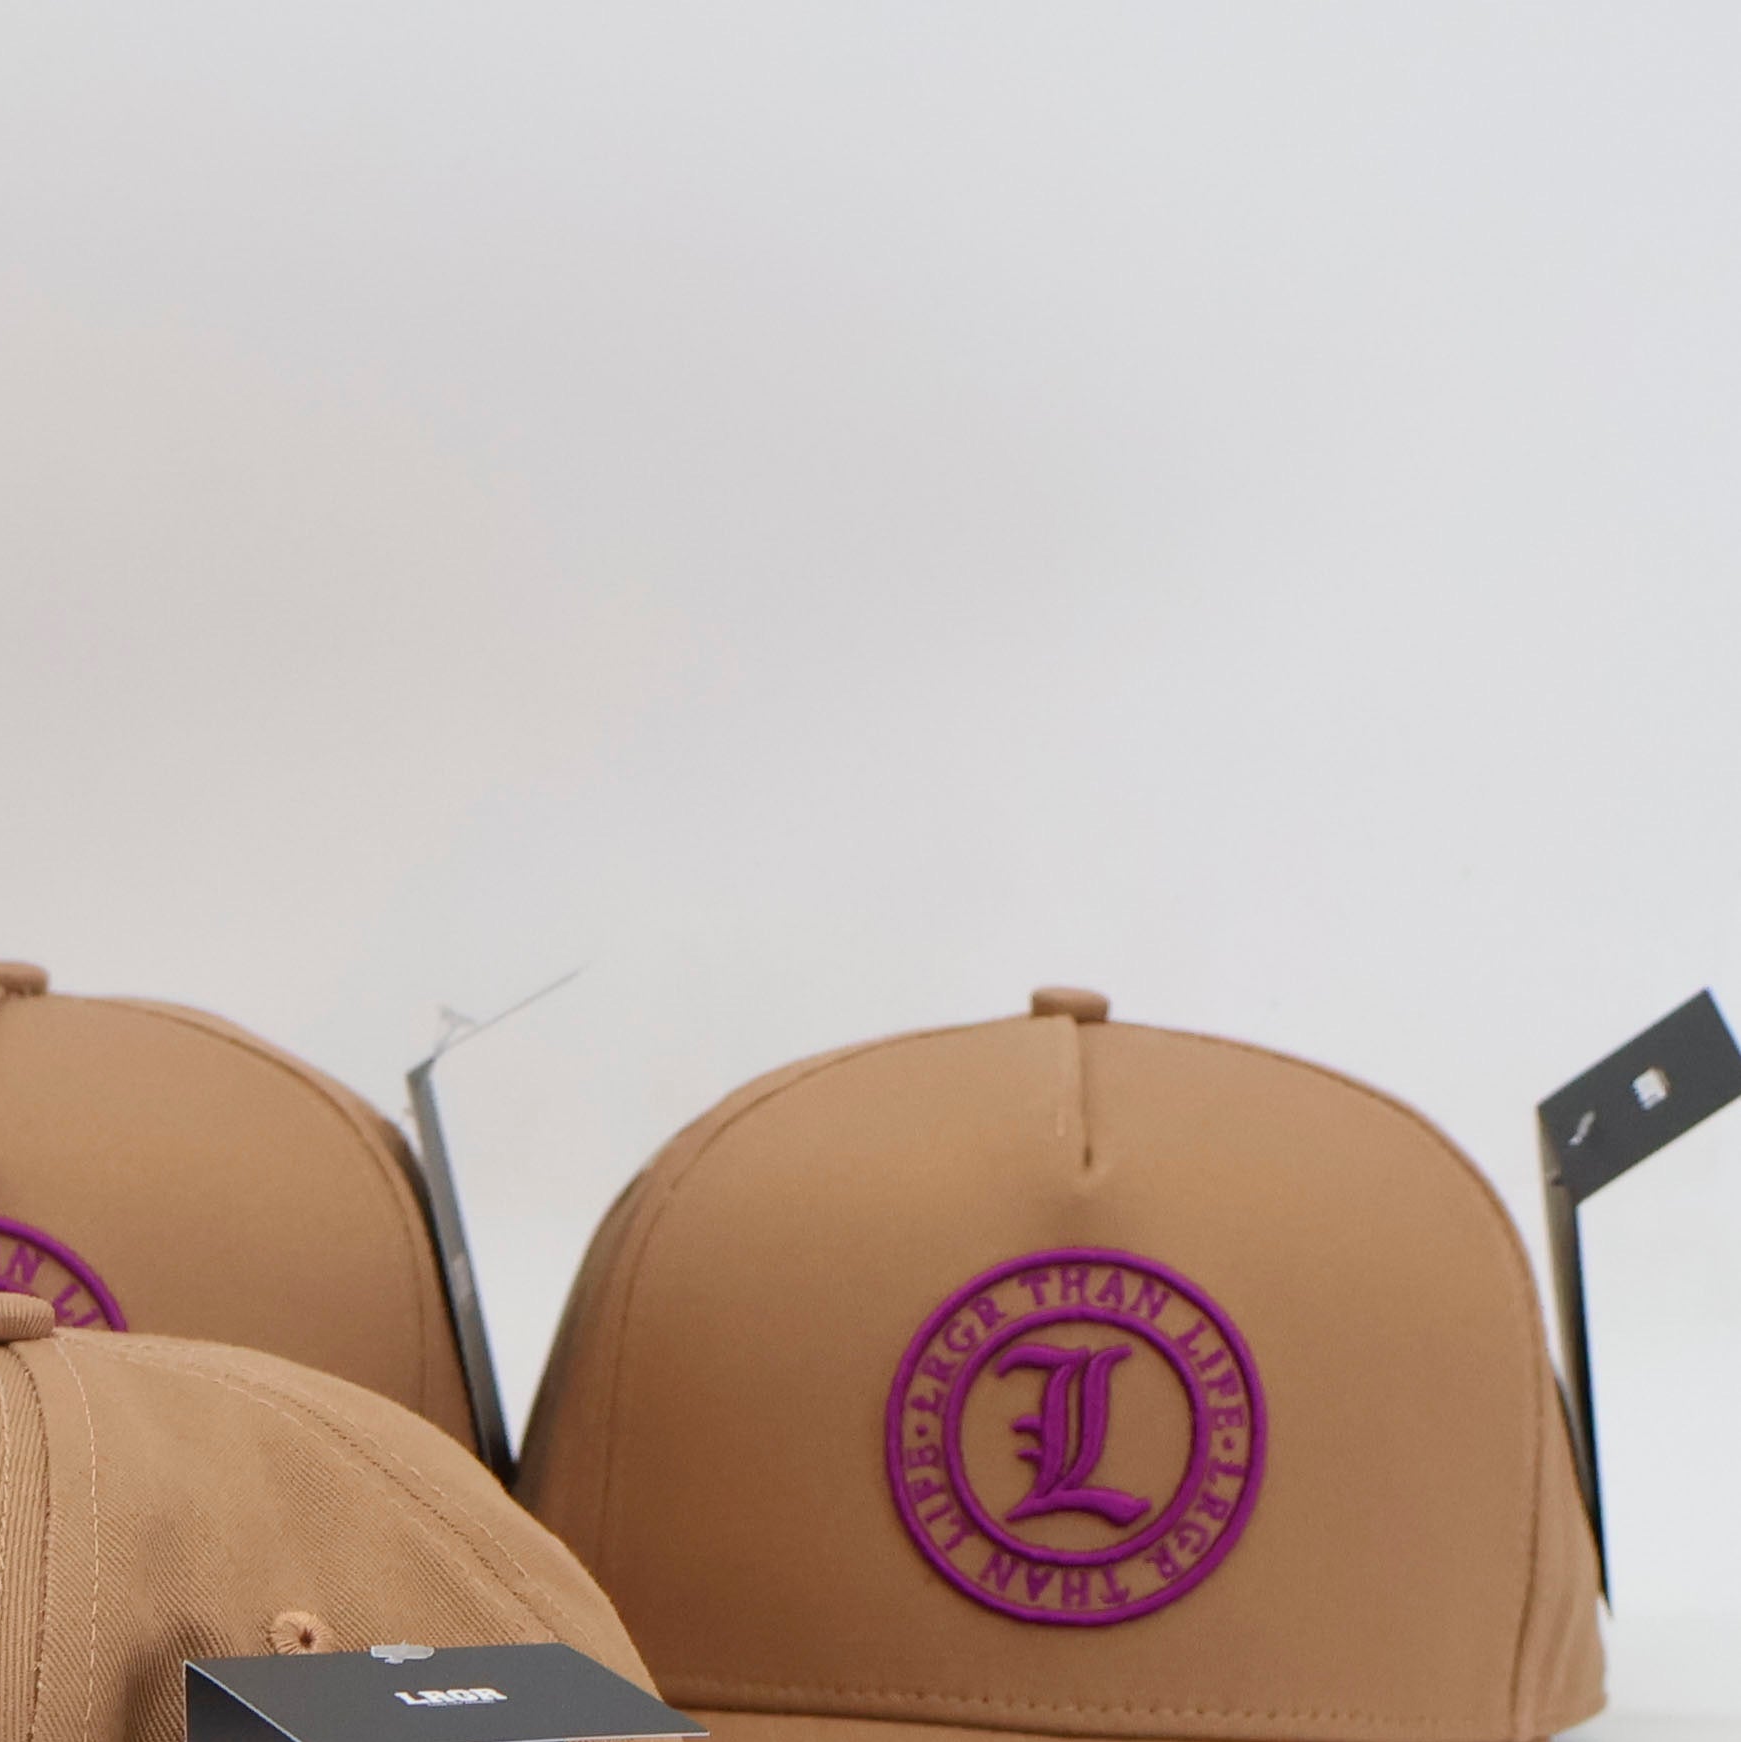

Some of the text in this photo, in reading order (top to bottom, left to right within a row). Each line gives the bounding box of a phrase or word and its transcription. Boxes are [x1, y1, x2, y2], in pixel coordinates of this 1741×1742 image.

[911, 1264, 1244, 1430] LRGR THAN LIFE
[996, 1345, 1152, 1528] L
[907, 1444, 1245, 1607] LRGR THAN LIFE
